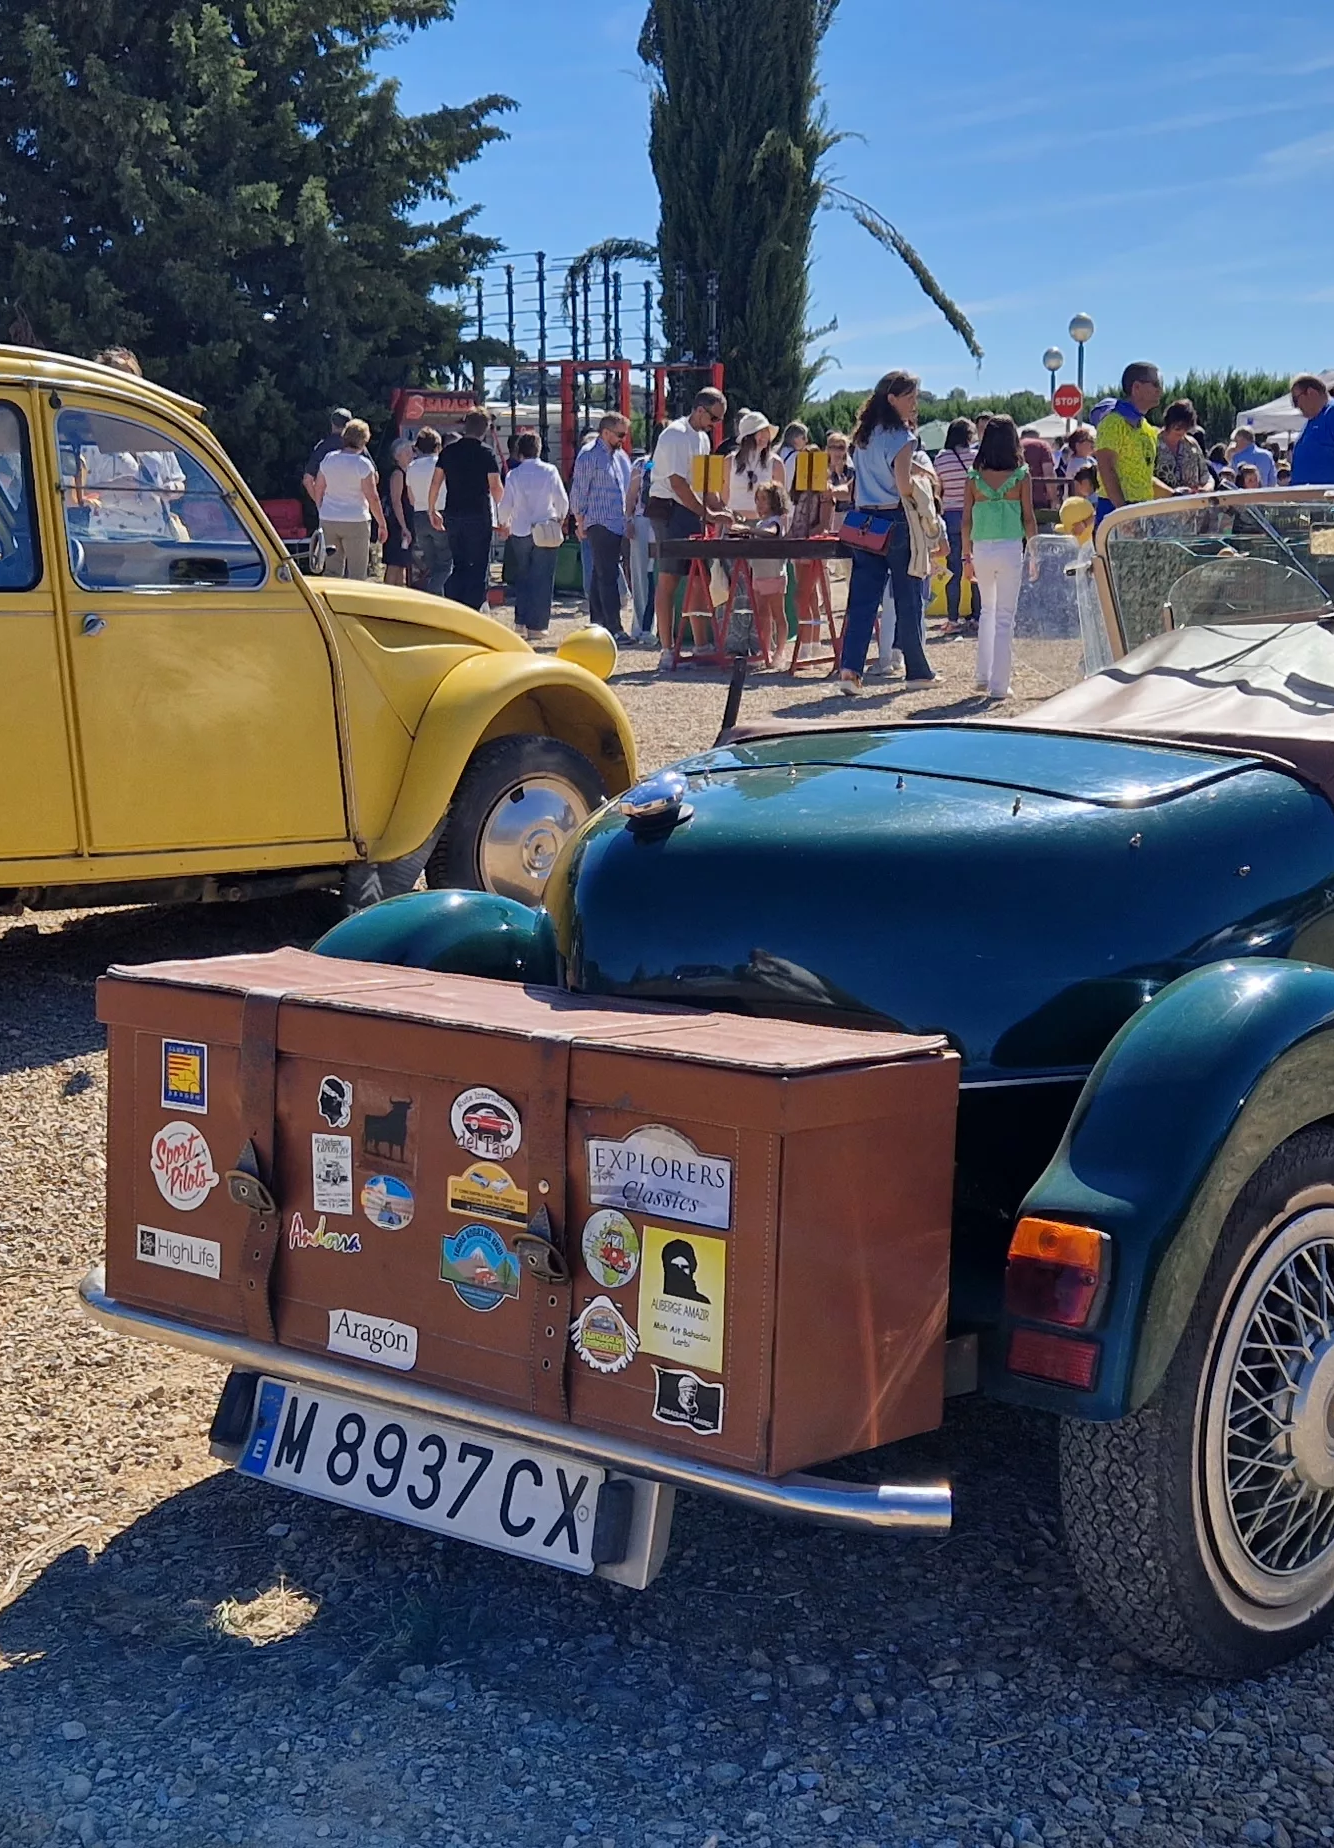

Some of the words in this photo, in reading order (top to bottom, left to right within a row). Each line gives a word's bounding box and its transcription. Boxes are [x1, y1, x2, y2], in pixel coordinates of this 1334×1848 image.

[1055, 396, 1080, 406] STOP
[156, 1132, 201, 1175] Sport
[457, 1131, 478, 1150] del
[482, 1135, 514, 1160] Tajo
[170, 1161, 214, 1196] Pilots
[594, 1147, 725, 1189] EXPLORERS
[622, 1180, 699, 1213] Classics
[290, 1212, 361, 1252] Andorra
[651, 1298, 682, 1316] AUBERGE
[333, 1310, 409, 1354] Aragón
[653, 1321, 668, 1333] Moh
[252, 1438, 266, 1460] E
[274, 1395, 319, 1475] M
[326, 1412, 494, 1520] 8937
[499, 1459, 589, 1555] CX
